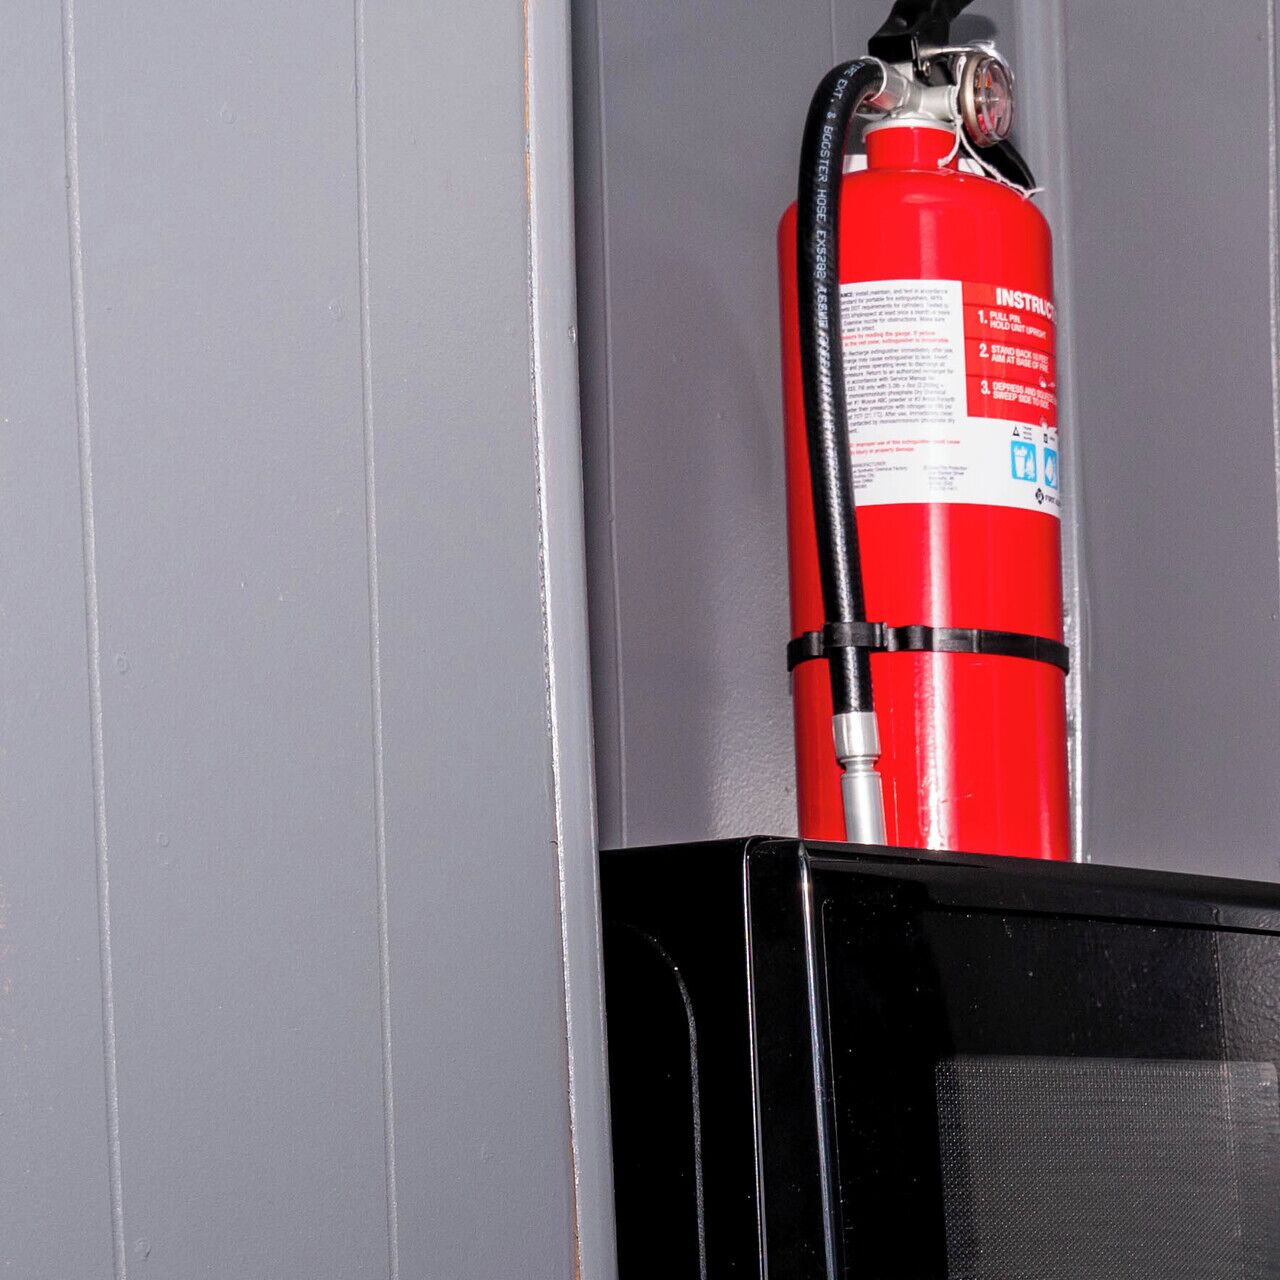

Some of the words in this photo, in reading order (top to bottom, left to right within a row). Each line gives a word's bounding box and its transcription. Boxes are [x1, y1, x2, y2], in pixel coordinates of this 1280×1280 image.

[831, 79, 848, 102] EXT.
[818, 125, 834, 183] BOOSTER
[815, 189, 828, 222] HOSE
[978, 309, 988, 324] 1.
[989, 311, 1009, 321] PULL
[989, 320, 1010, 330] HOLD
[981, 380, 991, 394] 3.
